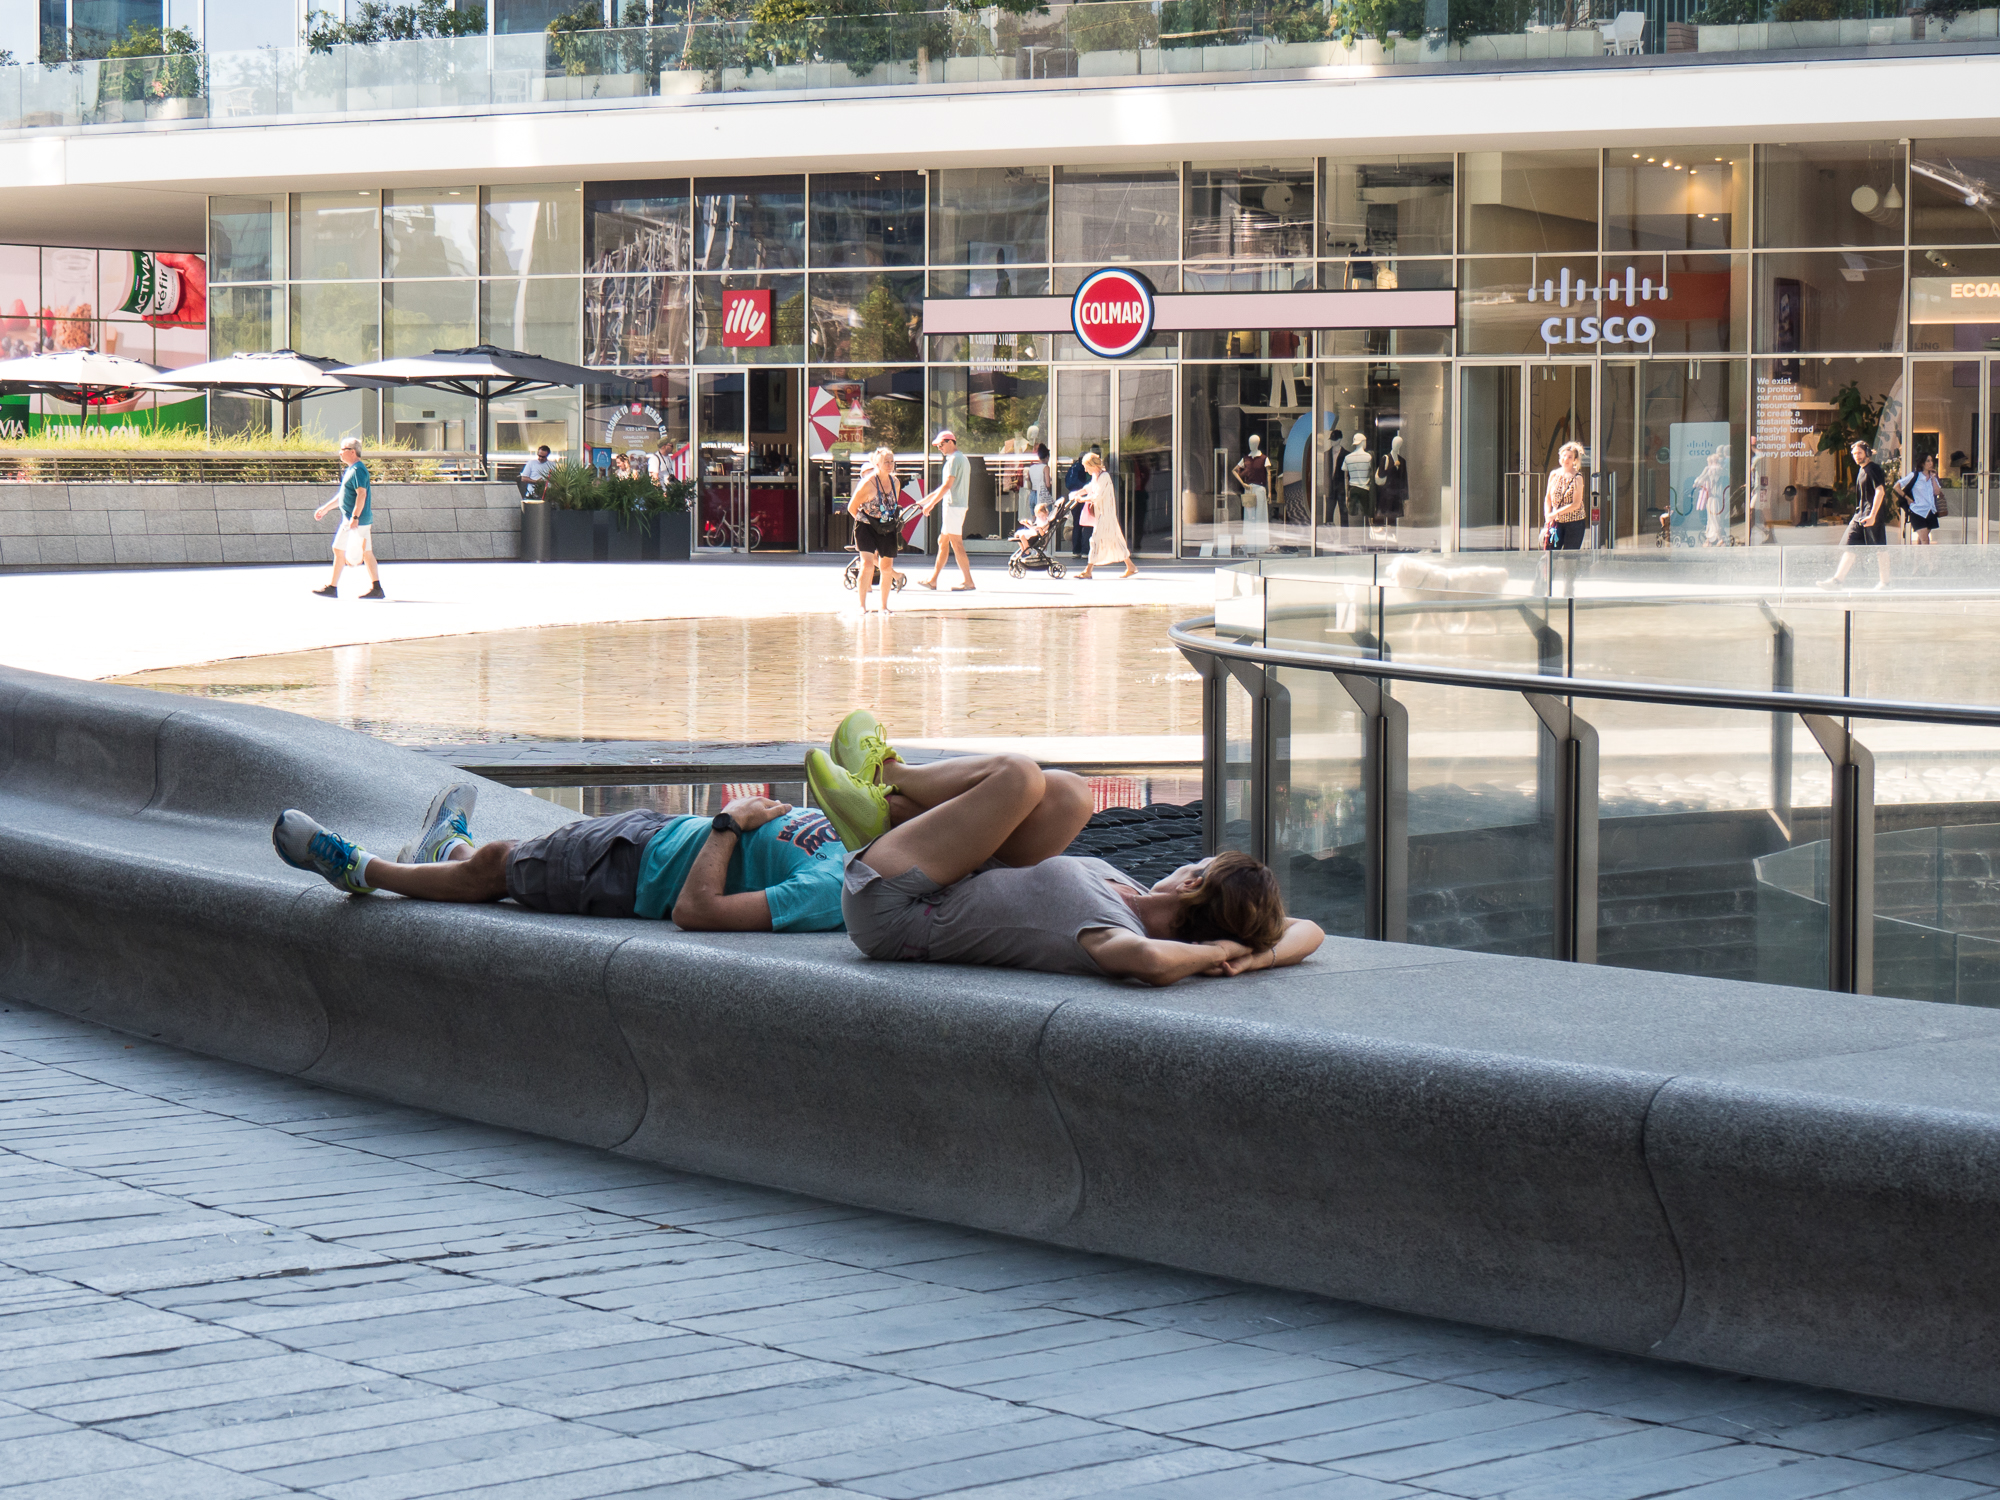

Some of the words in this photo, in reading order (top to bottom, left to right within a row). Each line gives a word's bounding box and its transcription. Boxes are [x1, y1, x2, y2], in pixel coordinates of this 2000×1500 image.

[134, 254, 150, 313] ACTIVIA
[155, 269, 168, 311] kéfir
[1951, 283, 2000, 298] ECOA
[725, 298, 766, 341] illy
[1081, 301, 1142, 325] COLMAR
[1540, 316, 1656, 344] CISCO
[1767, 386, 1797, 394] protect
[1772, 393, 1801, 401] natural
[1757, 426, 1787, 434] lifestyle
[1790, 425, 1814, 433] brand
[1757, 434, 1786, 442] leading
[1780, 450, 1815, 459] product.
